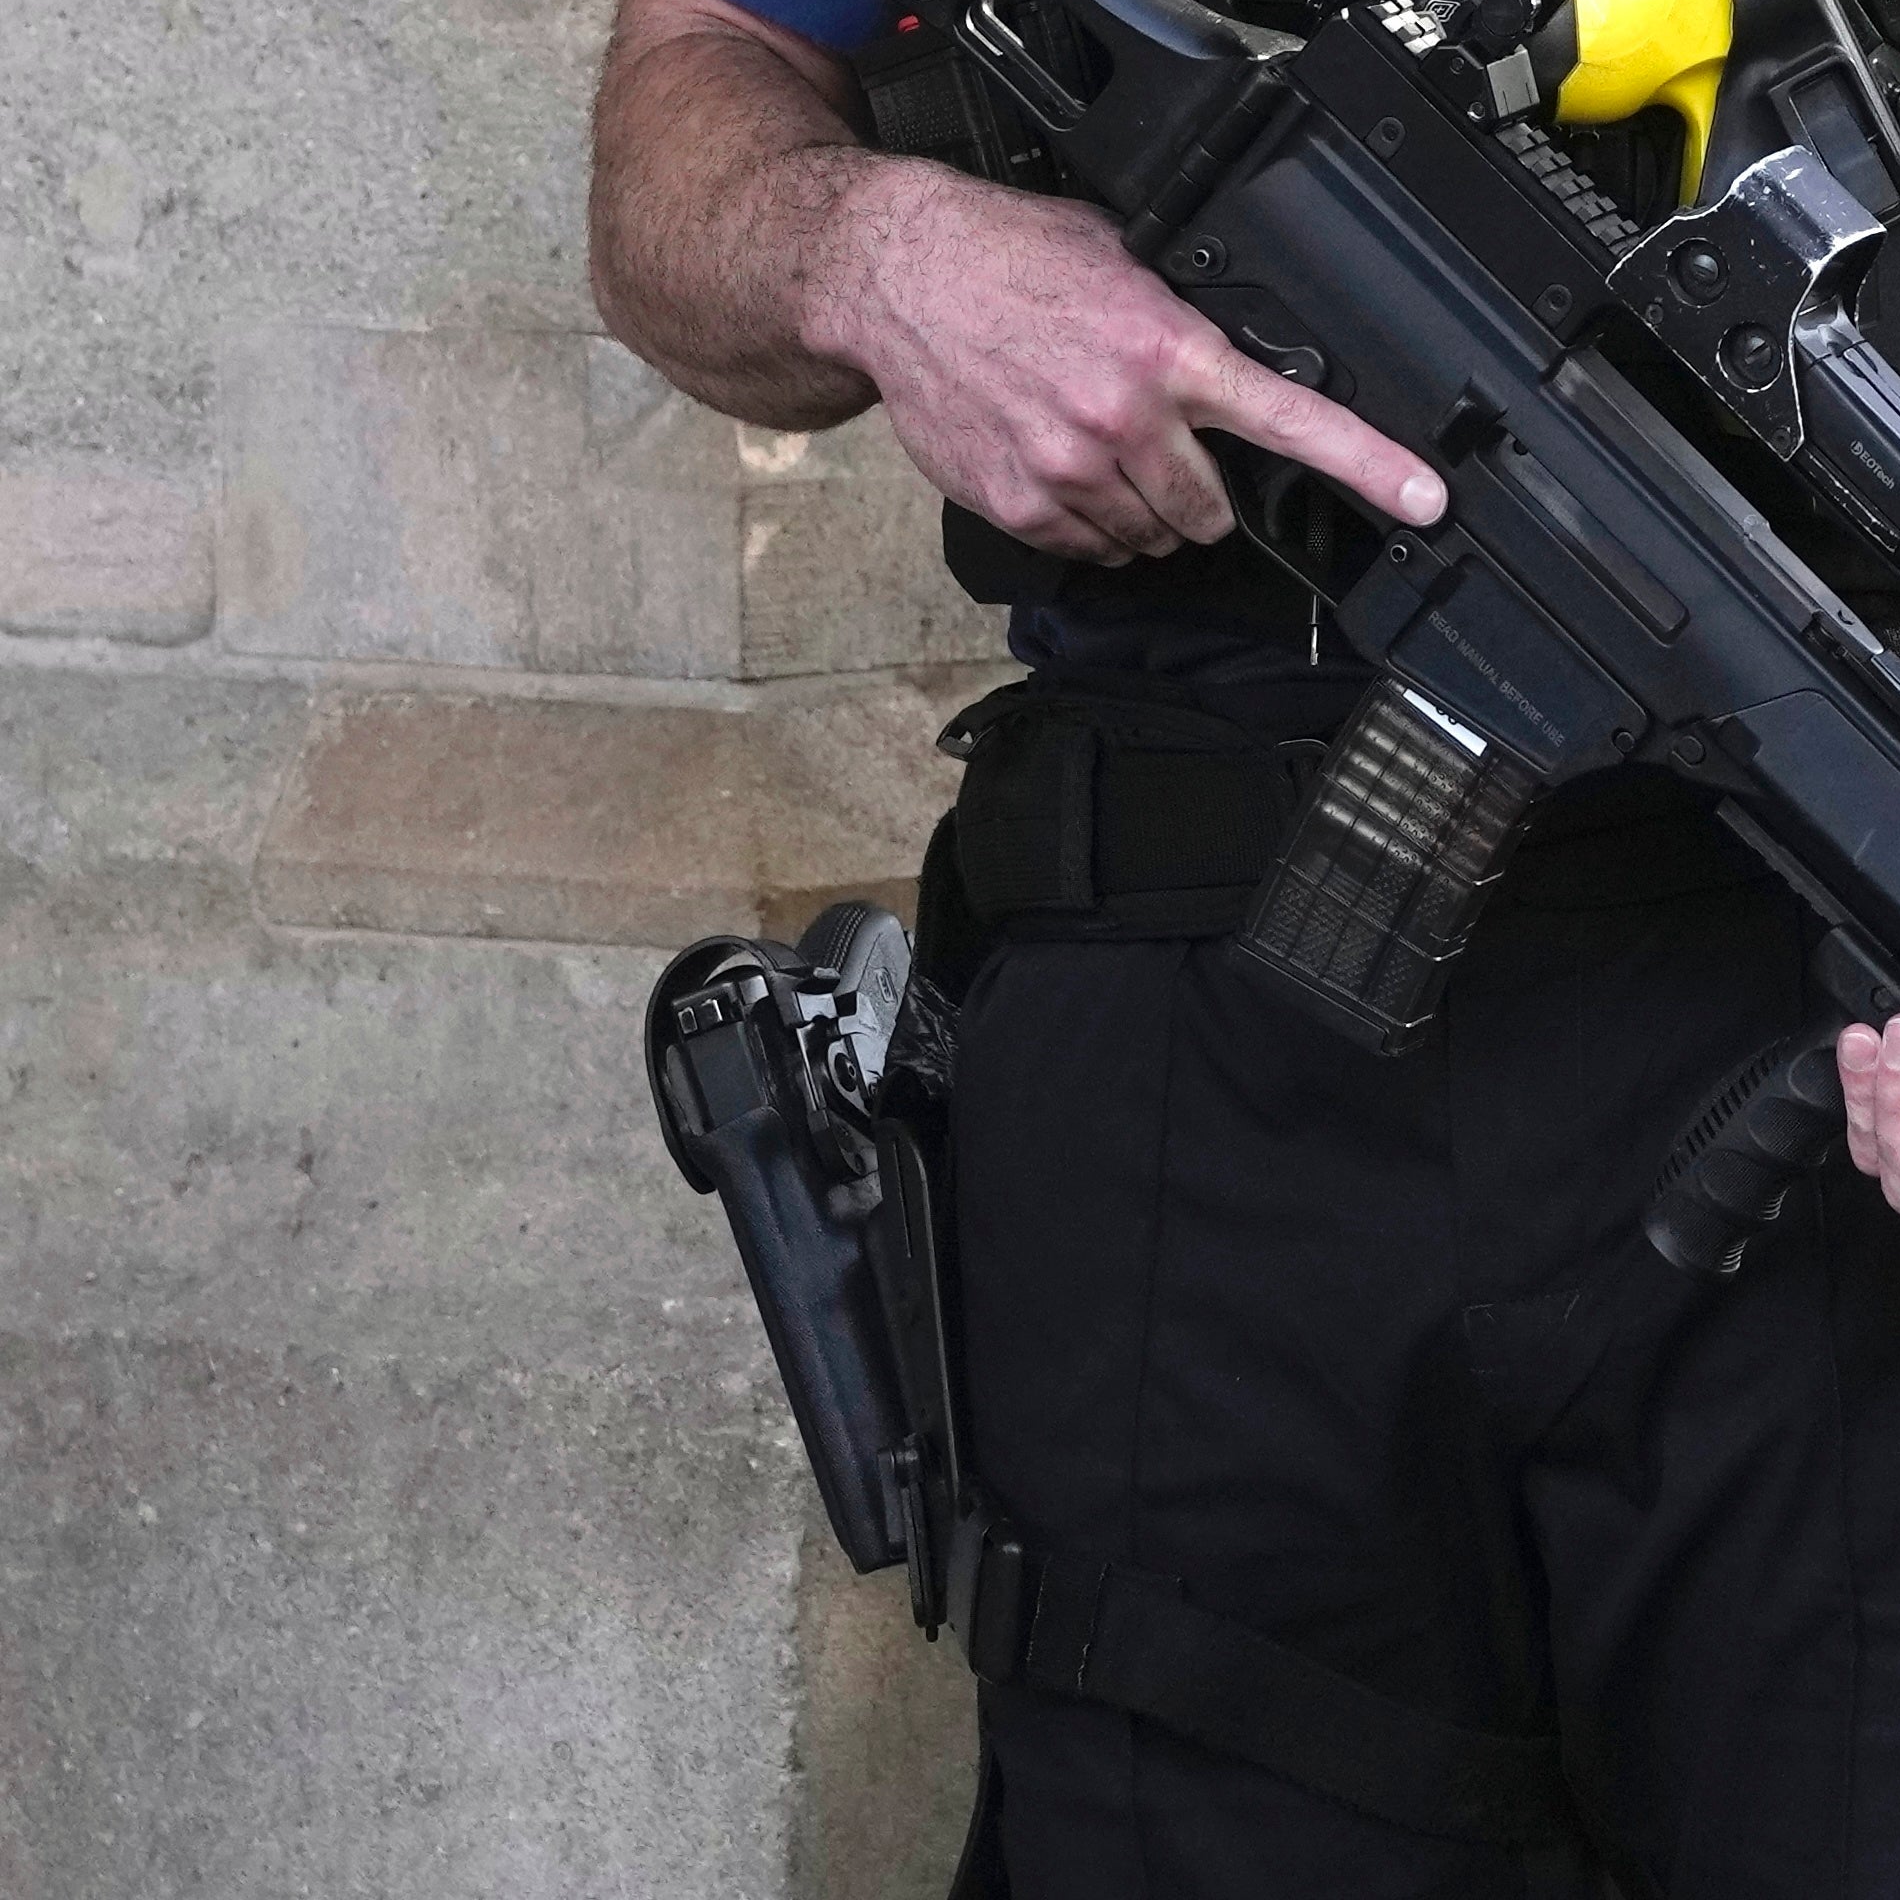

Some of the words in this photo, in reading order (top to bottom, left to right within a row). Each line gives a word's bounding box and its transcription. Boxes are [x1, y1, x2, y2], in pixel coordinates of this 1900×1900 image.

[1860, 450, 1895, 490] EOTech
[1428, 610, 1459, 643] READ
[1456, 638, 1501, 685] MANUAL
[1500, 680, 1543, 725] BEFORE
